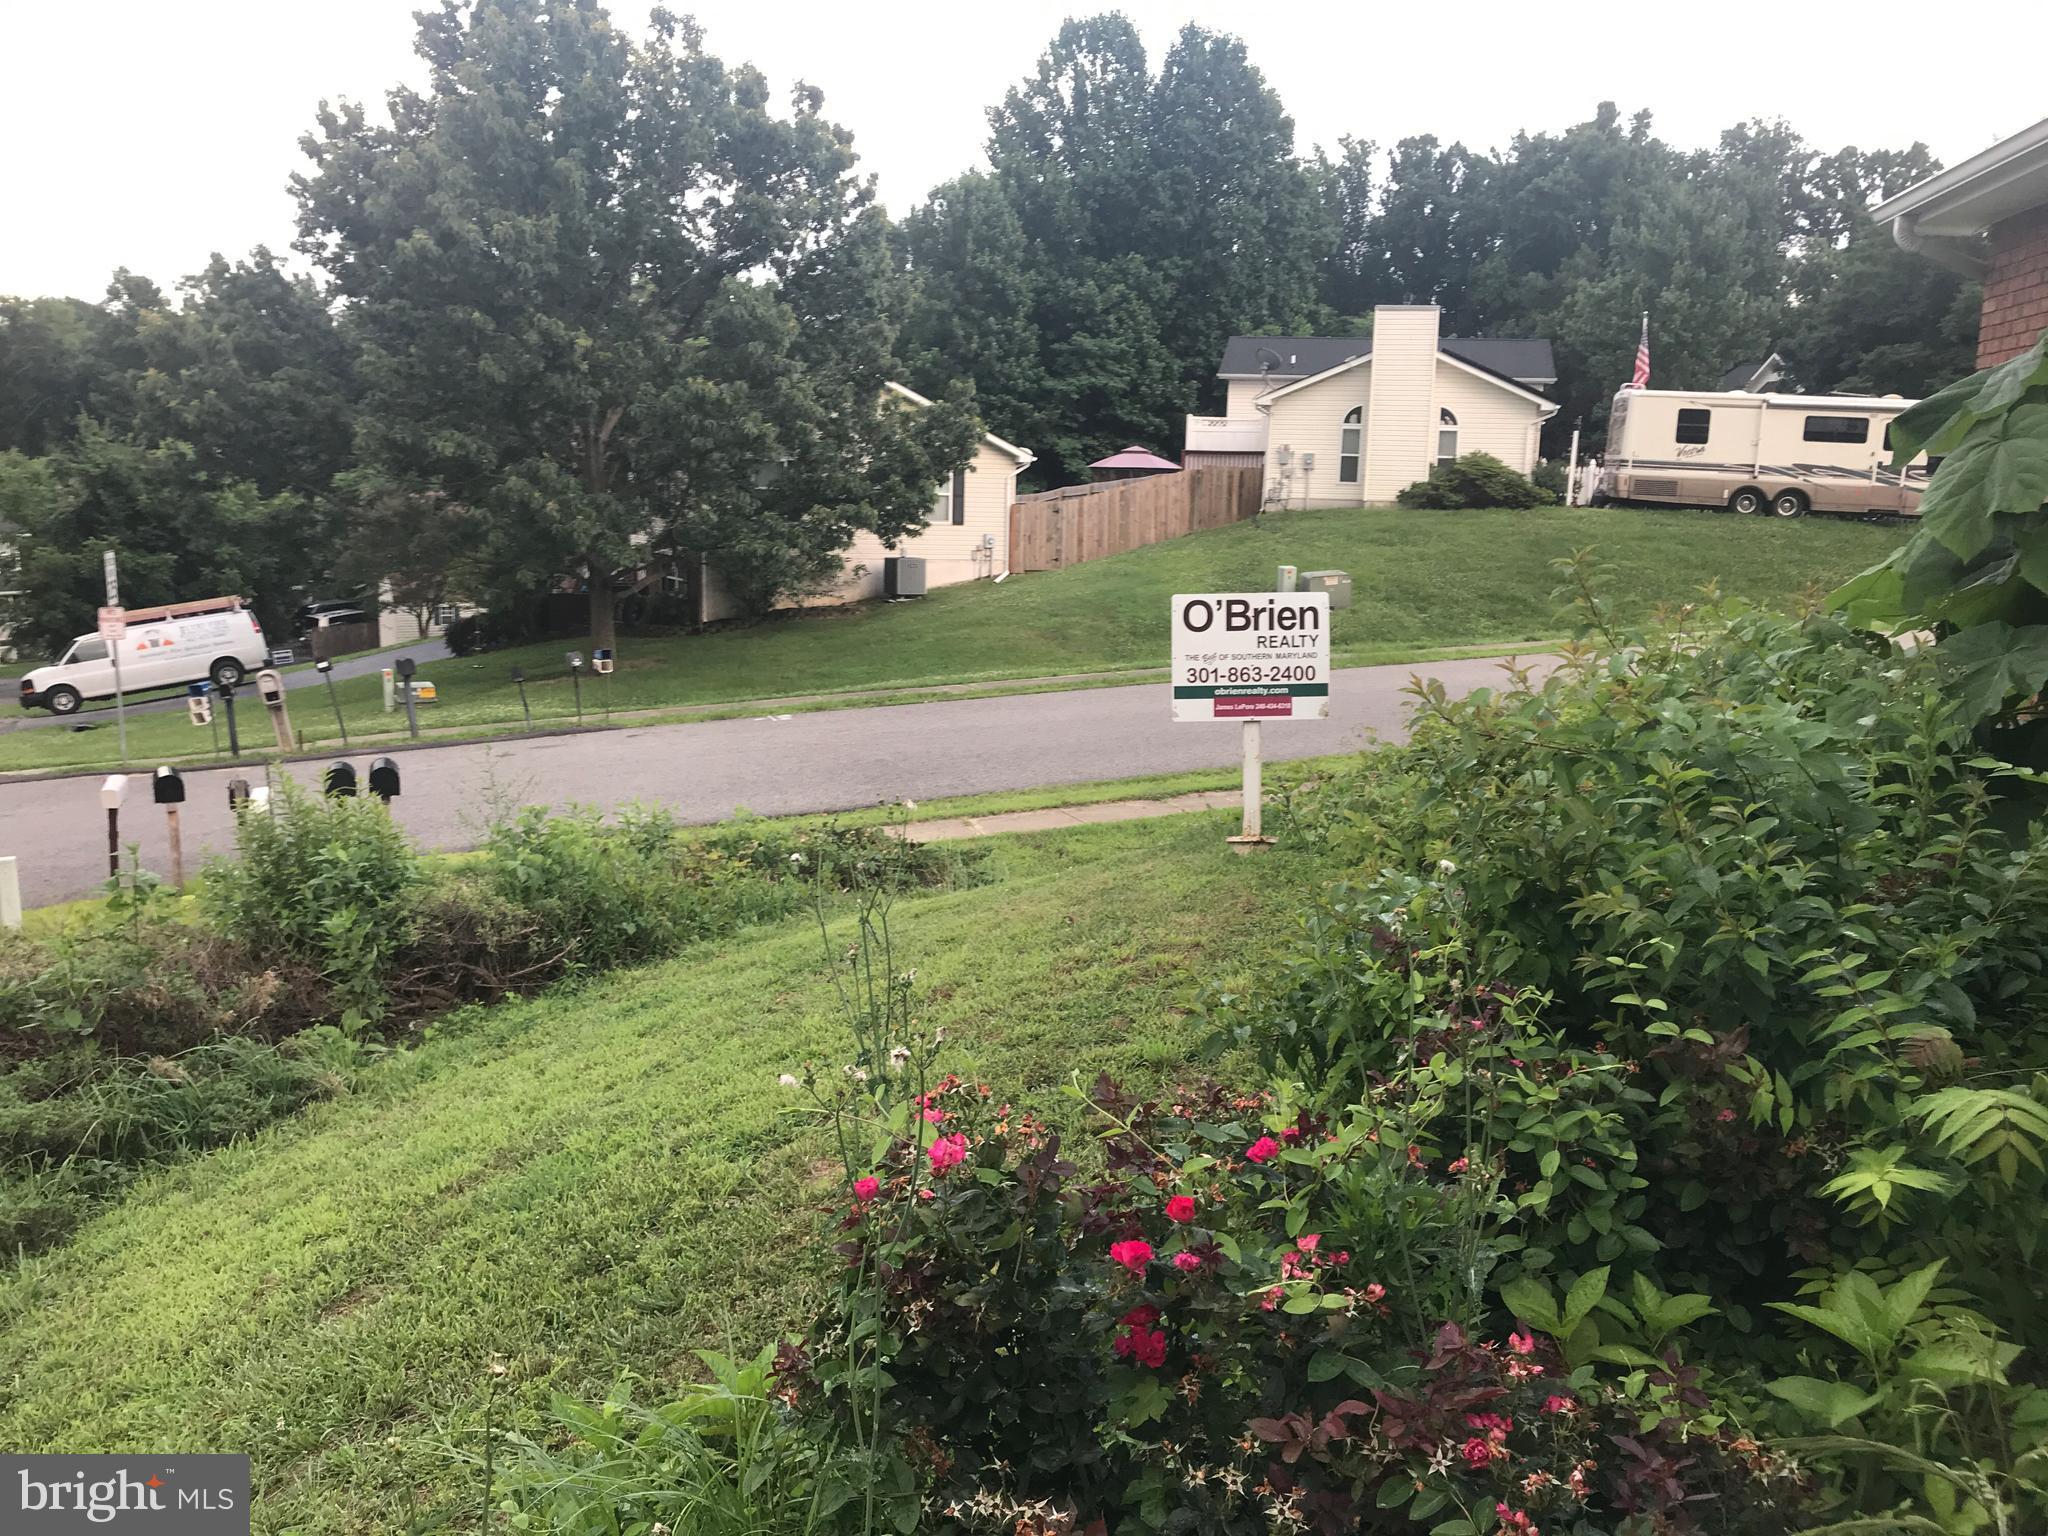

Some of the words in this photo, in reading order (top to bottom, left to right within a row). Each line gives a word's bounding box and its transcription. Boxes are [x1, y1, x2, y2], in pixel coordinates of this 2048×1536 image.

[1183, 599, 1320, 633] O'Brien
[1257, 635, 1319, 649] REALTY
[1185, 654, 1200, 662] THE
[1231, 653, 1273, 661] SOUTHERN
[1275, 652, 1318, 660] MARYLAND
[1186, 665, 1316, 683] 301-863-2400
[1214, 687, 1289, 696] obrienrealty.com
